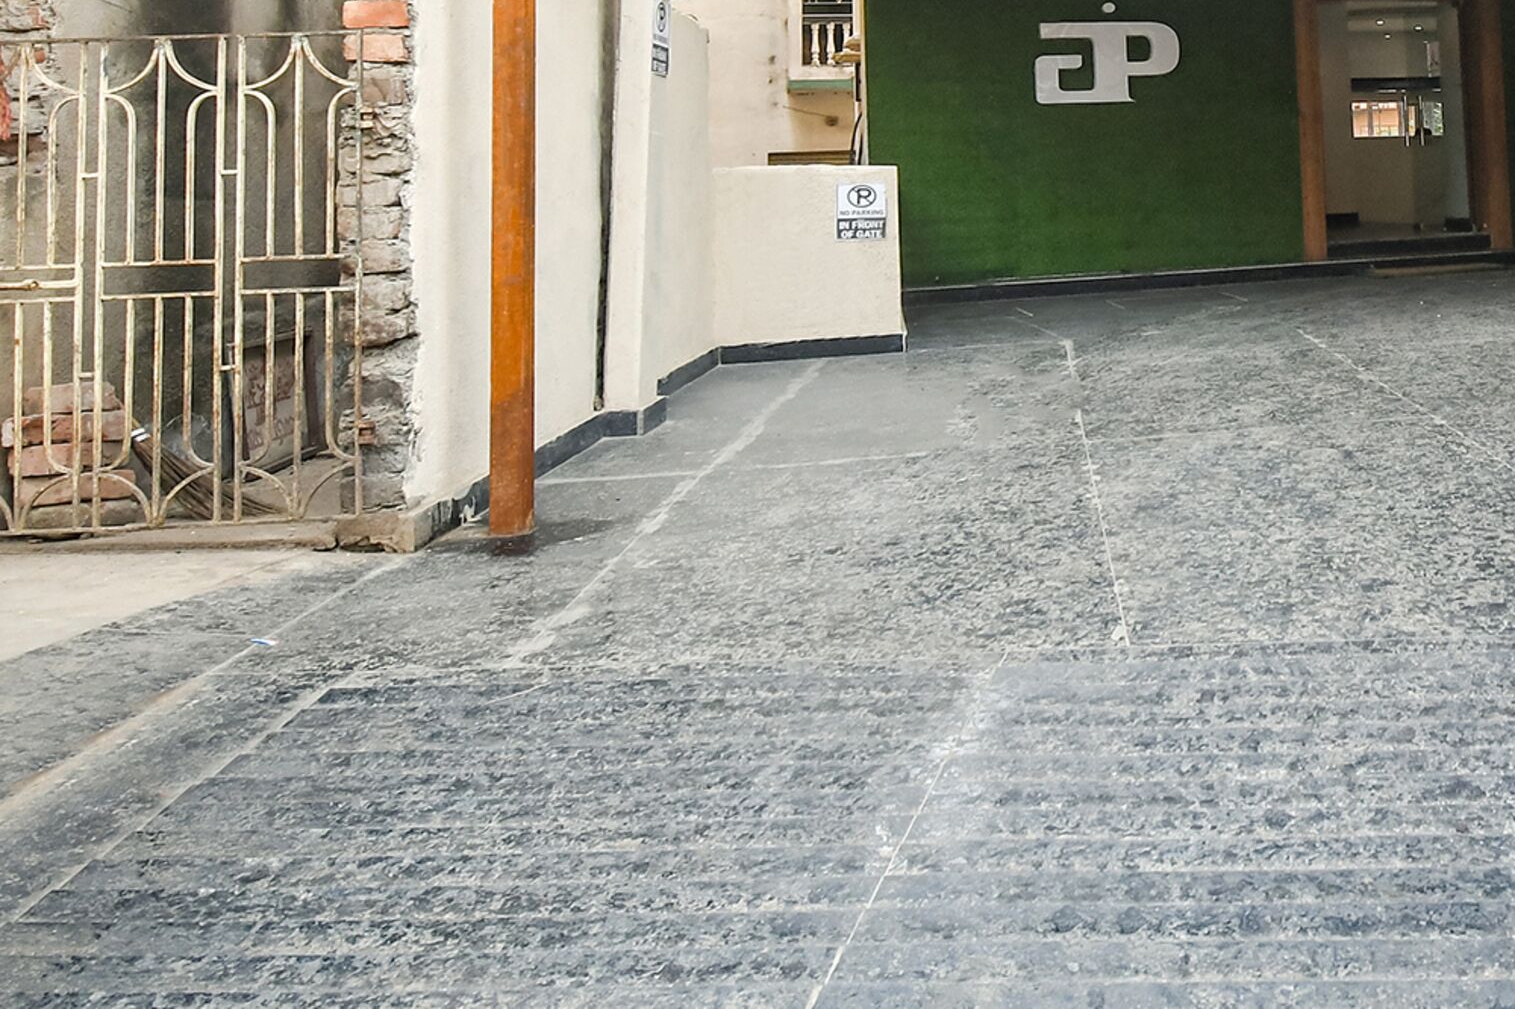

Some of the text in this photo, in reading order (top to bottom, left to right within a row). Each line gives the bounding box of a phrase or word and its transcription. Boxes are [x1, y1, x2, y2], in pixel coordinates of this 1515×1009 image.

[851, 220, 883, 230] FRONT
[840, 230, 881, 239] OF GATE
